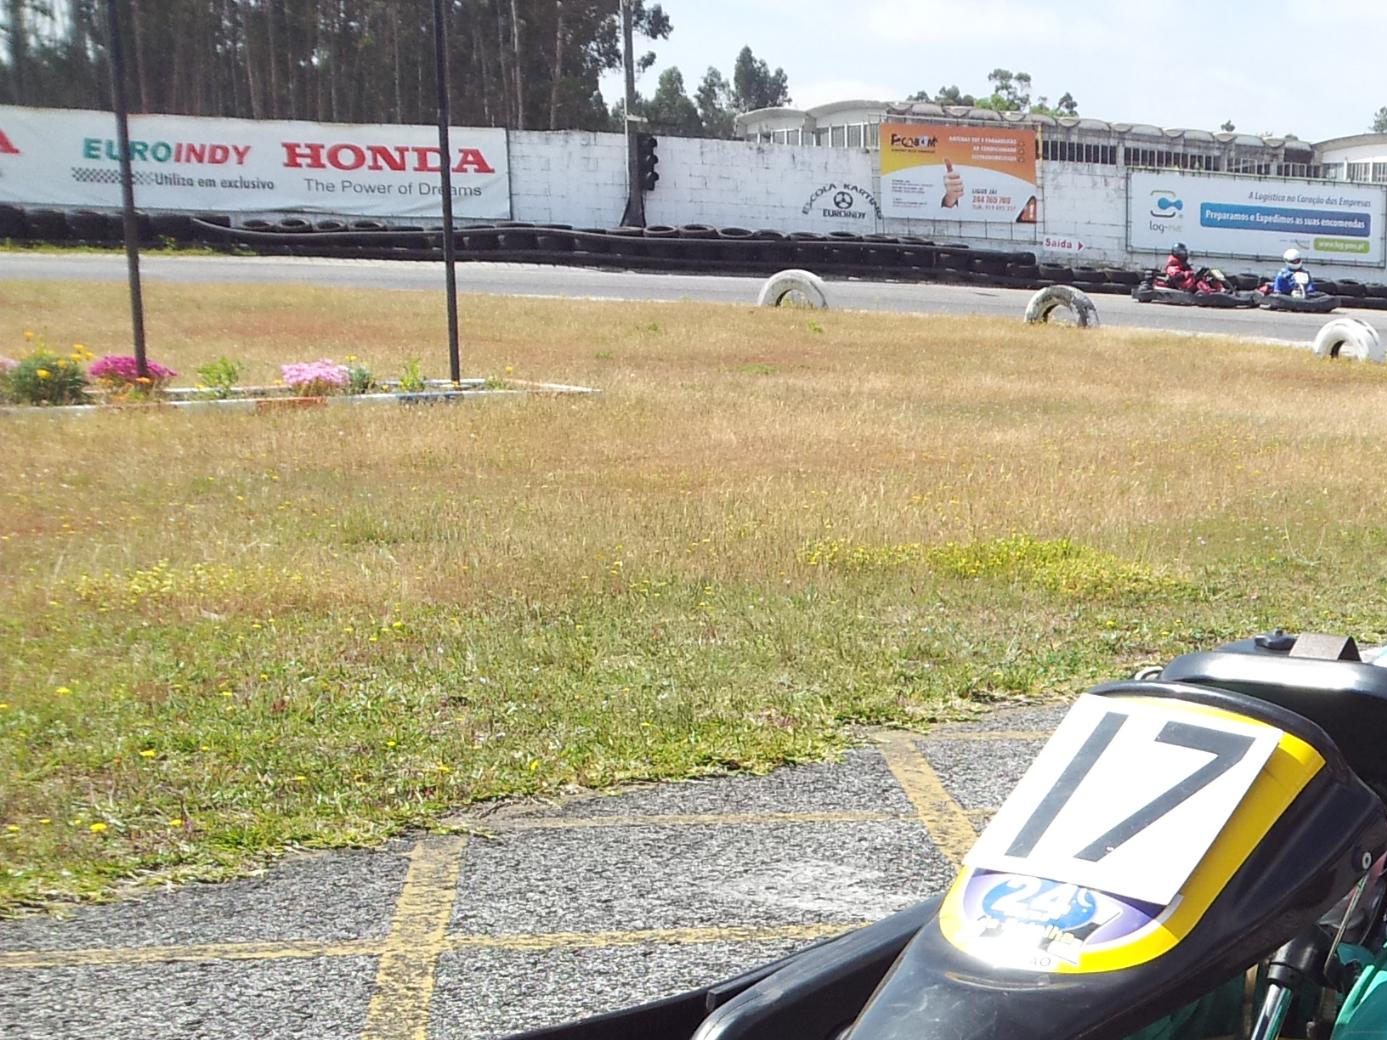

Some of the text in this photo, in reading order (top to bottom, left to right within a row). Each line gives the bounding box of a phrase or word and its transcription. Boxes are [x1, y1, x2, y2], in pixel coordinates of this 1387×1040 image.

[83, 138, 252, 165] EUROINDY
[282, 142, 496, 174] HONDA
[155, 172, 275, 190] Utiliza em exclusivo
[304, 178, 482, 197] The Power of Dreams
[1205, 209, 1249, 222] Preparamos
[1256, 213, 1294, 224] Expedimos
[1304, 218, 1320, 226] suas
[1321, 218, 1365, 229] encomendas
[1004, 711, 1256, 863] 17
